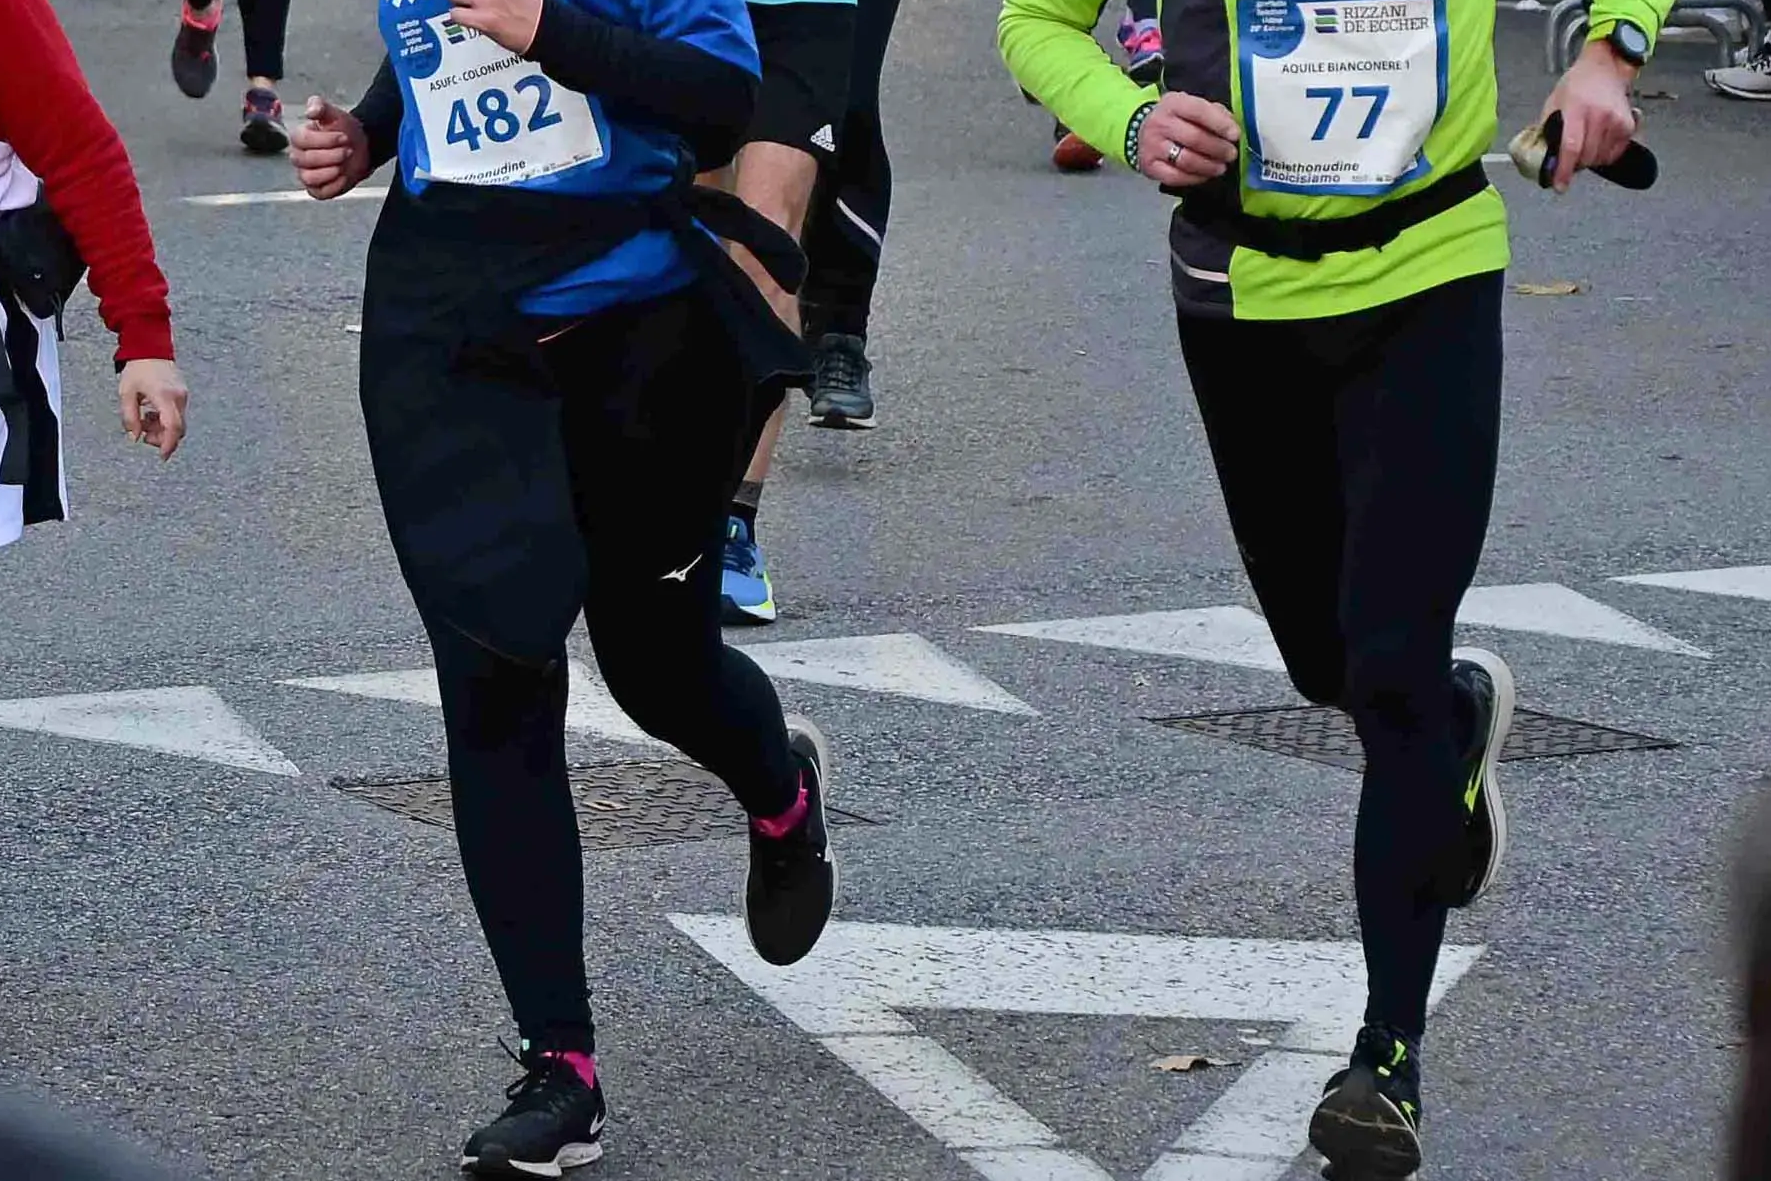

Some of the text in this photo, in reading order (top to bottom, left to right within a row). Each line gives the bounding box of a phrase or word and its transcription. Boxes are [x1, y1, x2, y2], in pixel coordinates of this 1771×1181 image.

[1343, 5, 1407, 19] RIZZANI
[1344, 17, 1429, 34] DE ECCHER
[1282, 60, 1411, 74] AQUILE BIANCONERE 1
[445, 73, 563, 152] 482
[1305, 84, 1391, 141] 77
[1262, 159, 1360, 172] #telethonudine
[1262, 170, 1341, 184] #noicisiamo
